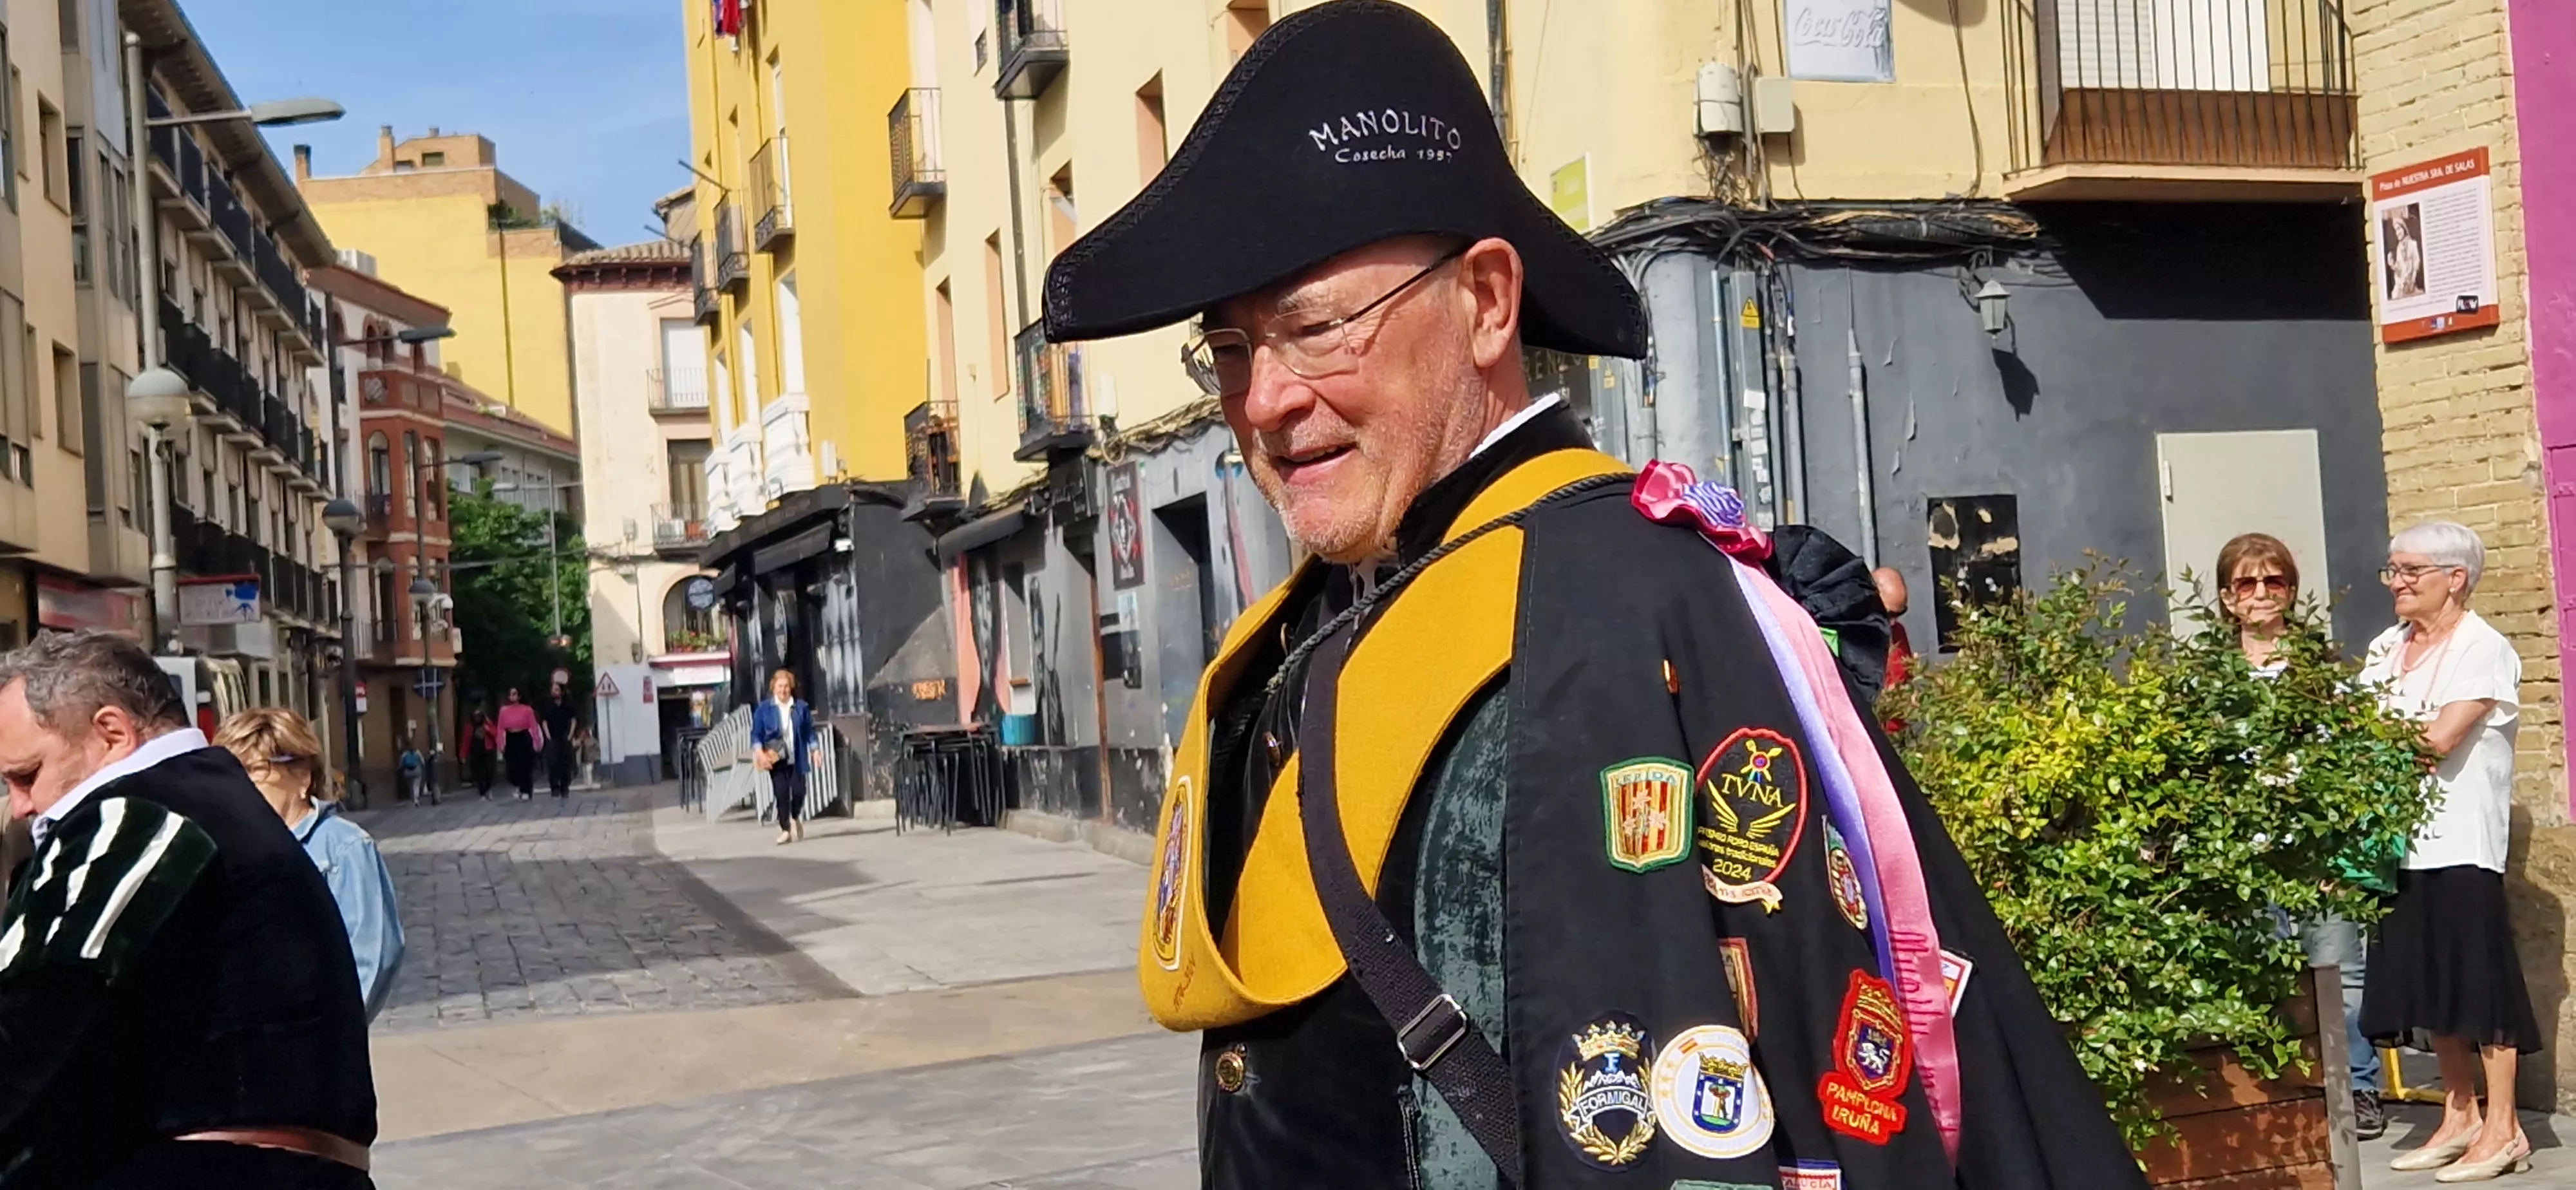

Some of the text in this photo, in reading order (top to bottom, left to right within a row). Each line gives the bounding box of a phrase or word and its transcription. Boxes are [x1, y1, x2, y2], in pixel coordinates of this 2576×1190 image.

[1309, 108, 1461, 151] MANOLITO
[1335, 144, 1406, 162] Cosecha
[2401, 170, 2429, 185] NUESTRA
[2445, 163, 2454, 175] DE
[2454, 158, 2476, 173] SALAS
[1721, 773, 1784, 808] TVNA
[1712, 858, 1752, 882] 2024
[1604, 1052, 1621, 1073] F
[1579, 1090, 1647, 1116] FORMIGAL
[1826, 1081, 1897, 1122] PAMPLONA
[1832, 1104, 1880, 1136] IRUÑA
